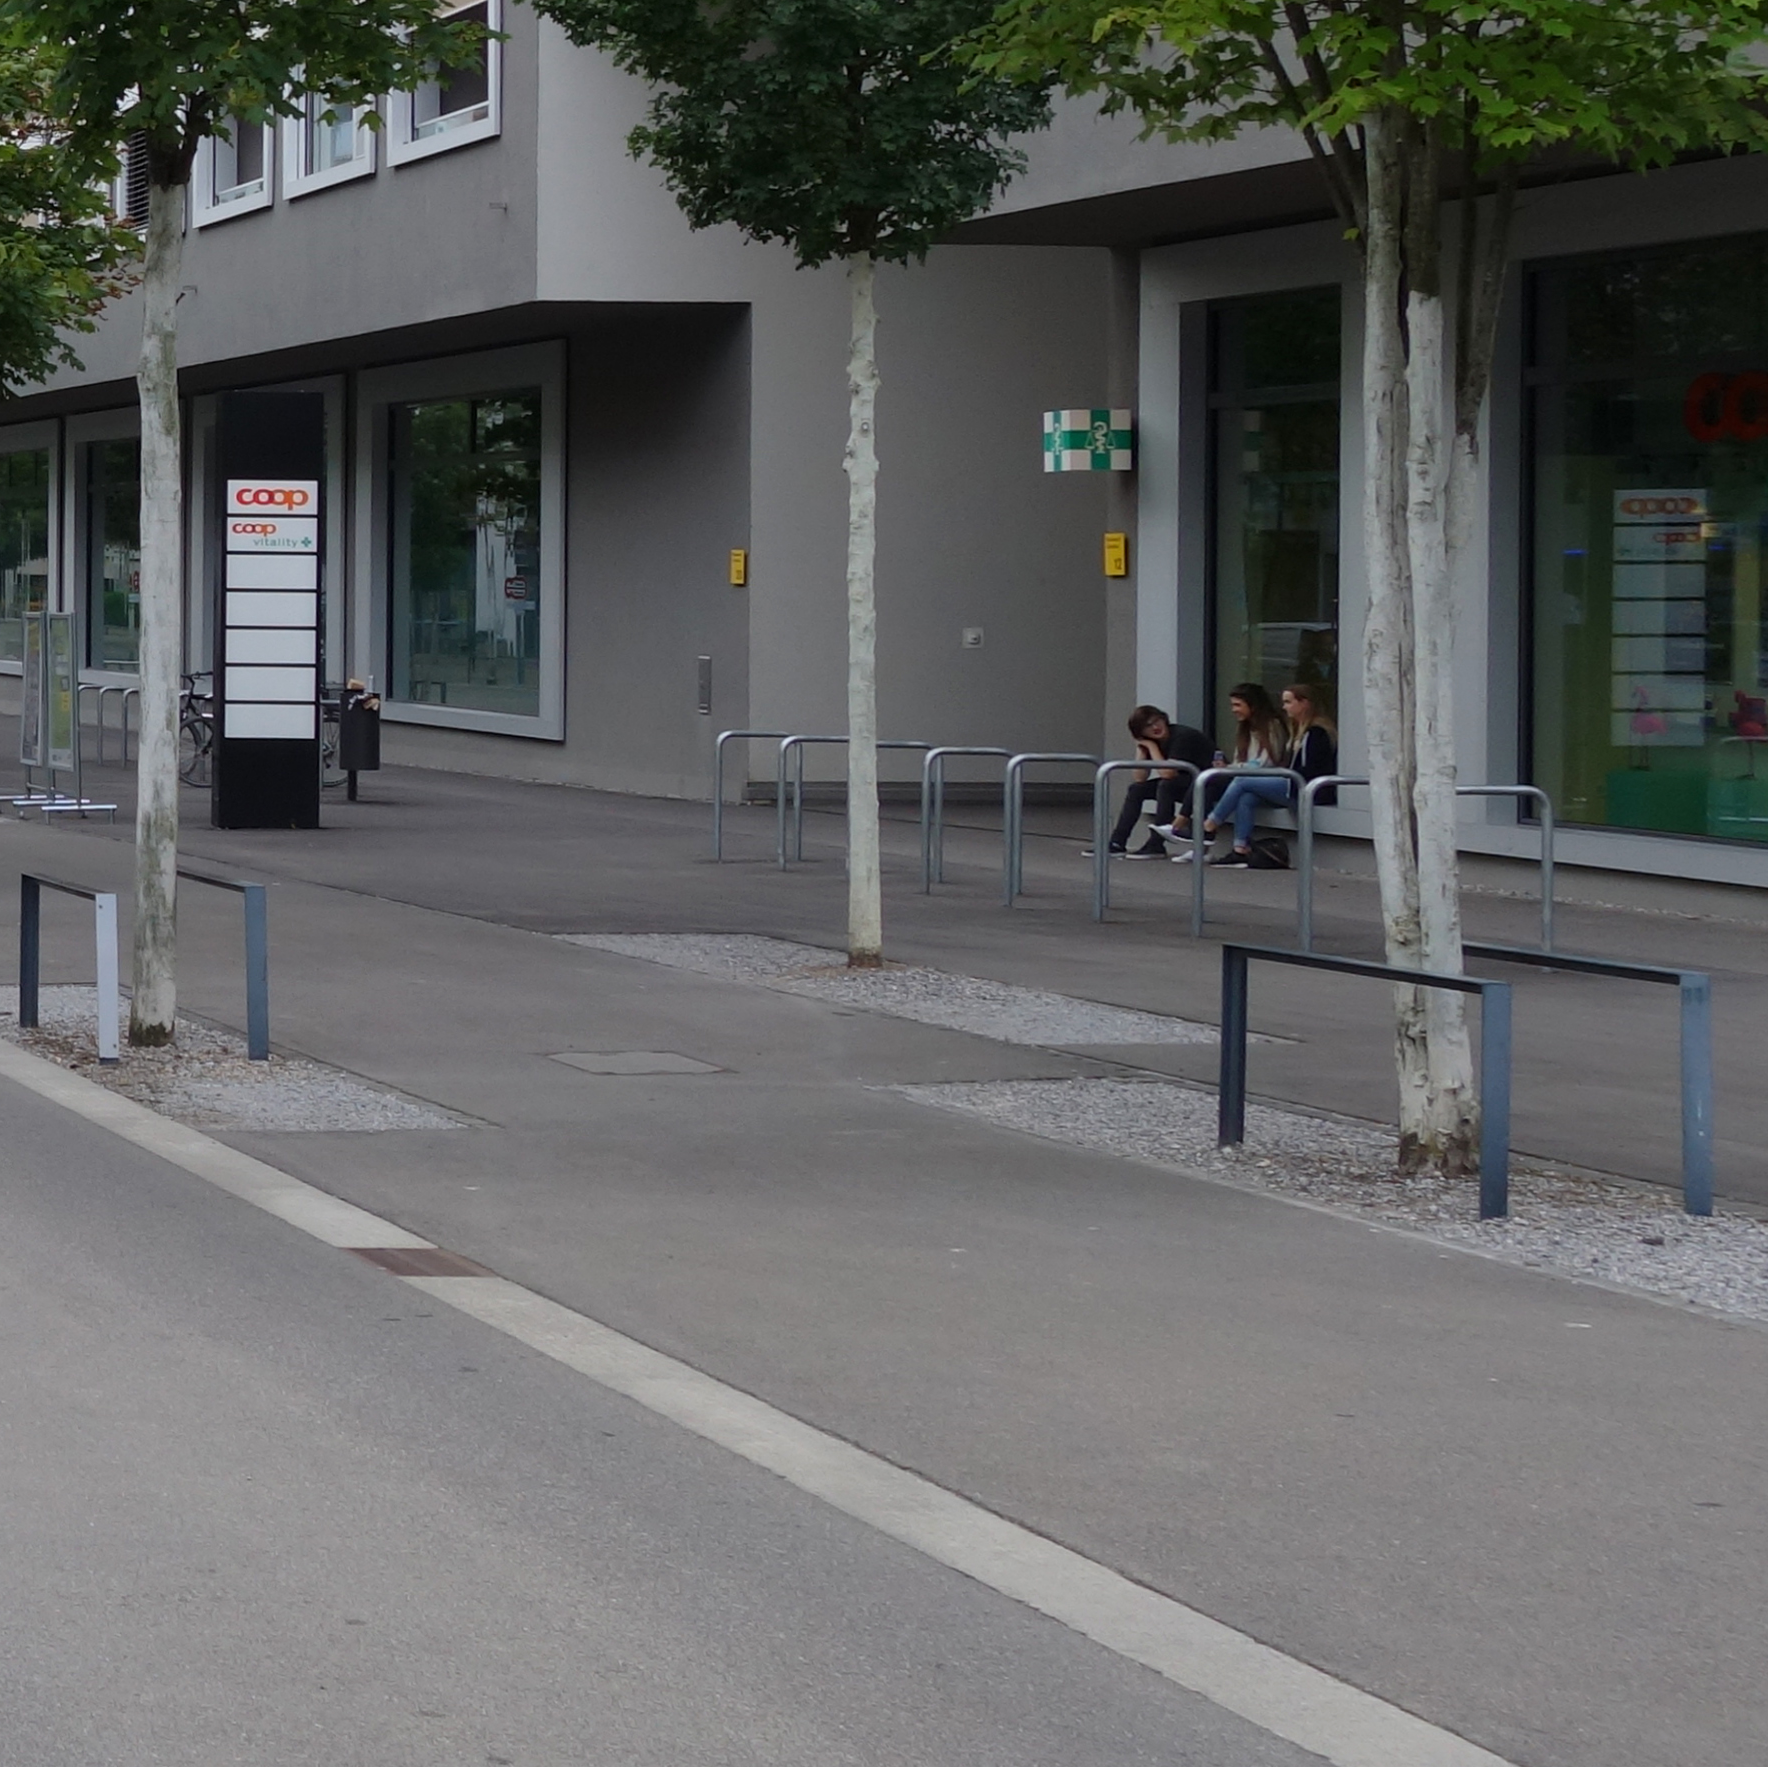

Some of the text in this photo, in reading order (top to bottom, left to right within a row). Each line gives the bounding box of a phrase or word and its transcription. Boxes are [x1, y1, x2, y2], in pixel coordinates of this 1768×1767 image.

[236, 488, 309, 511] coop
[232, 523, 276, 537] coop
[253, 537, 298, 548] vitality
